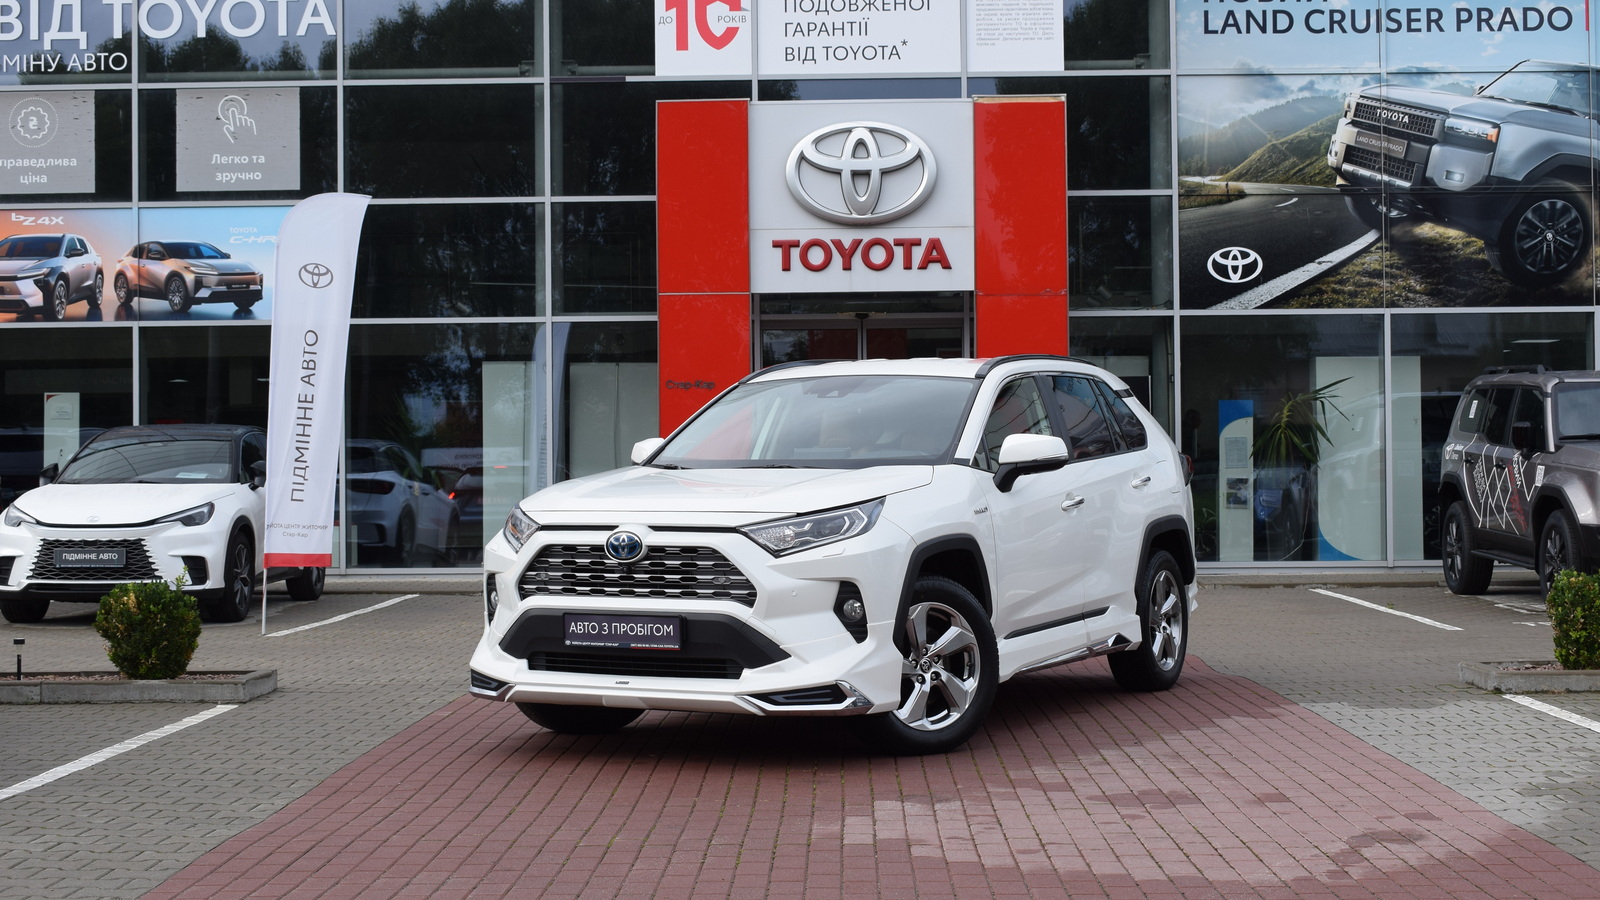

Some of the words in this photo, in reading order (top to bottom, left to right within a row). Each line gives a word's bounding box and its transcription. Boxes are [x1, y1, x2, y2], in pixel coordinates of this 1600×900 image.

[0, 0, 87, 50] ВІД
[102, 0, 337, 39] TOYOTA
[658, 16, 673, 25] ДО
[717, 15, 747, 23] РОКІВ
[1203, 9, 1294, 34] LAND
[1304, 8, 1445, 34] CRUISER
[1456, 6, 1573, 32] PRADO
[784, 17, 870, 37] ГАРАНТІЇ
[67, 52, 128, 71] АВТО
[784, 46, 817, 64] ВІД
[1376, 108, 1409, 124] TOYOTA
[211, 153, 249, 164] Легко
[252, 155, 265, 163] та
[20, 172, 48, 184] ціна
[215, 171, 262, 183] зручно
[230, 226, 258, 234] TOYOTA
[771, 237, 953, 272] TOYOTA
[300, 329, 319, 387] АВТО
[665, 380, 716, 390] Стар-Кар
[290, 393, 314, 502] ПІДМІННЕ
[62, 553, 97, 561] ПІДМІННЕ
[569, 621, 599, 634] АВТО
[601, 623, 609, 634] З
[611, 623, 674, 636] ПРОБІГОМ
